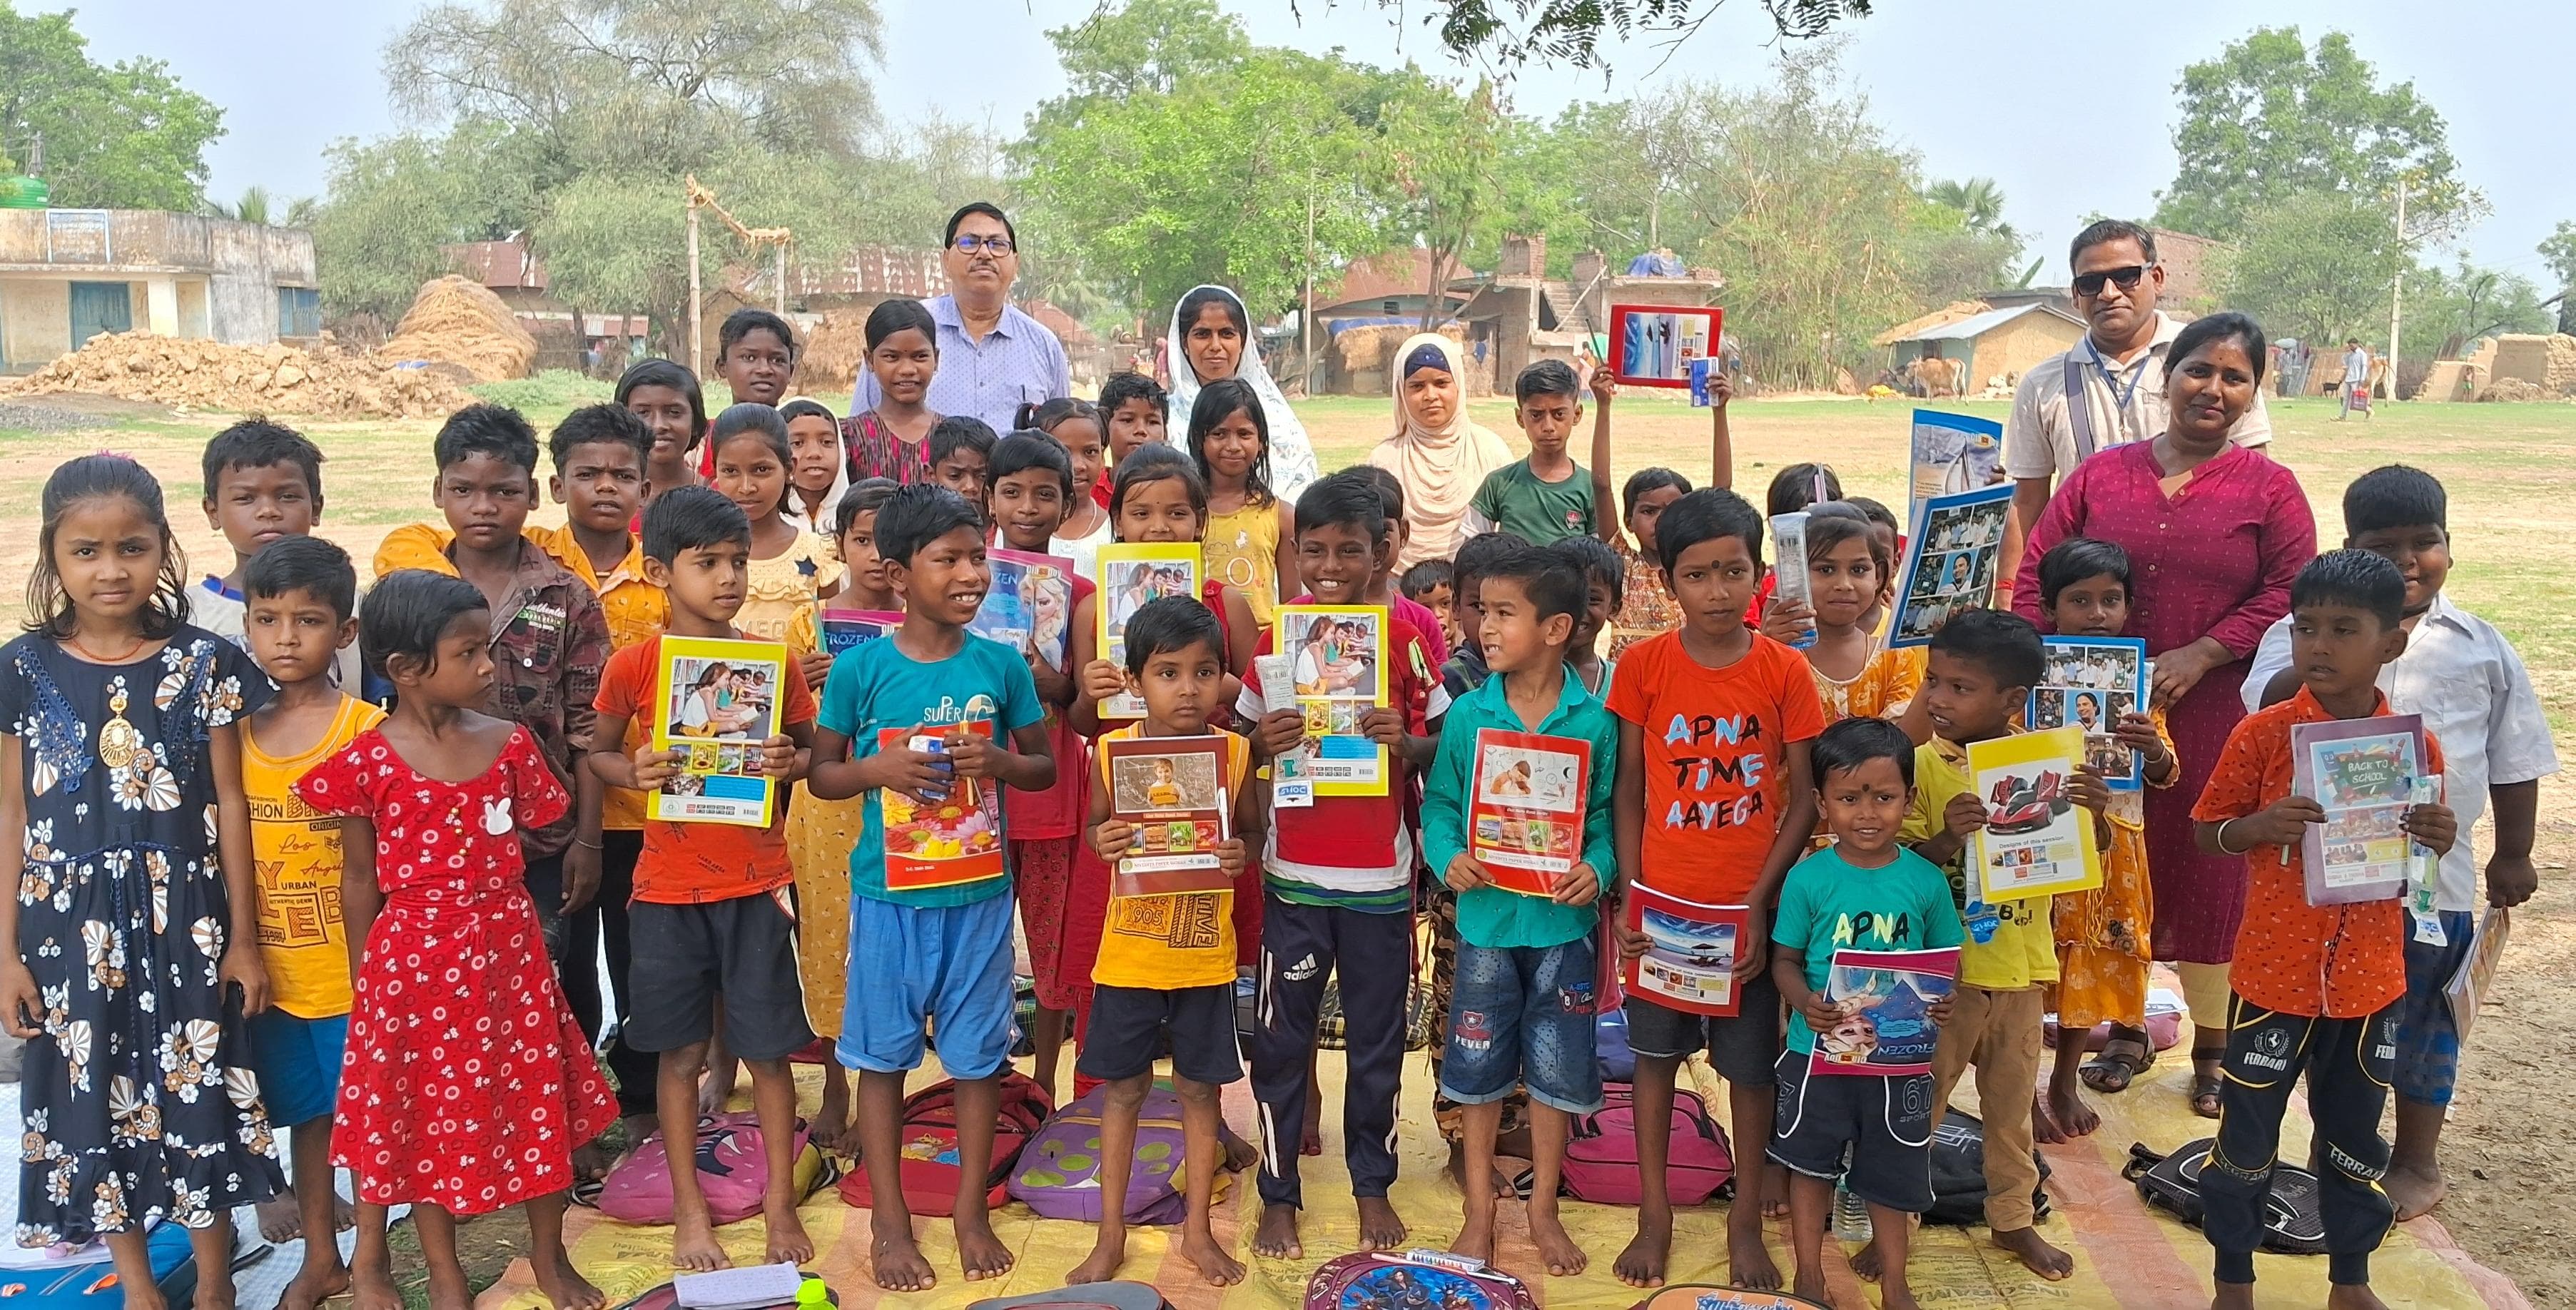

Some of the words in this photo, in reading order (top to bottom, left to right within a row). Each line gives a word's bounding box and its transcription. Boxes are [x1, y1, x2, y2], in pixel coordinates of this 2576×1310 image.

[924, 696, 961, 721] SUPER
[1663, 712, 1763, 748] APNA
[2348, 762, 2373, 772] BACK
[2375, 759, 2388, 768] TO
[2353, 773, 2387, 783] SCHOOL
[1665, 790, 1764, 831] AAYEGA
[281, 881, 317, 890] URBAN
[1832, 910, 1910, 949] APNA
[1456, 1034, 1491, 1050] FEVER
[1877, 1042, 1937, 1056] FROZEN
[2243, 1051, 2288, 1072] FERRARI
[1902, 1075, 1932, 1114] 67
